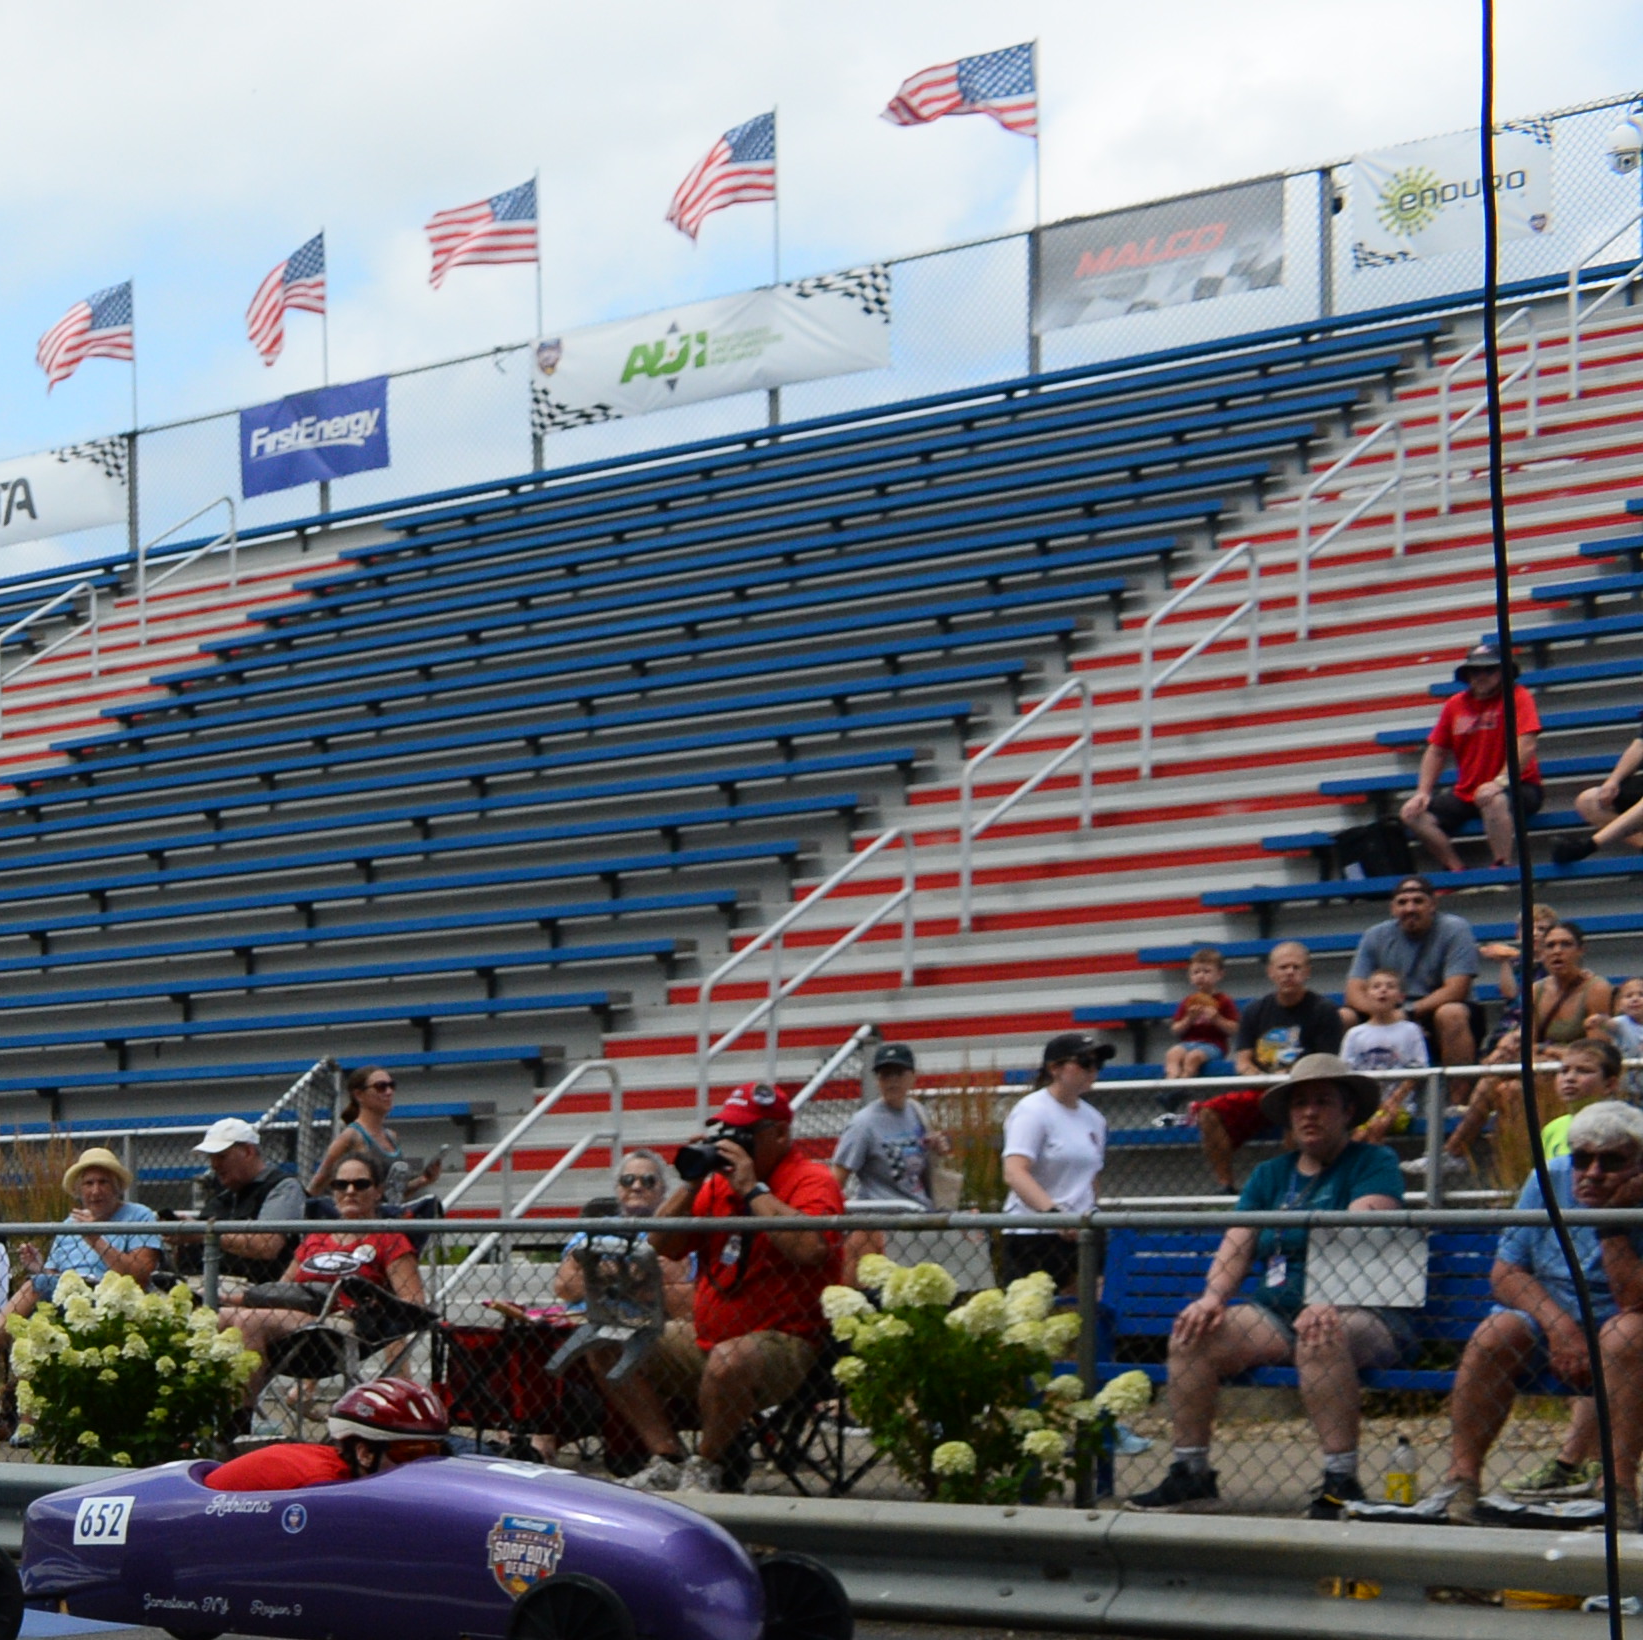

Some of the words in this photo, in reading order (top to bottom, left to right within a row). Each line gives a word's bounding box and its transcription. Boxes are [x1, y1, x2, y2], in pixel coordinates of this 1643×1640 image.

[1074, 222, 1228, 279] MALCO
[249, 408, 381, 459] FirstEnergy
[80, 1502, 125, 1538] 652
[205, 1494, 272, 1517] Adriana
[494, 1541, 526, 1562] SOAP
[526, 1545, 553, 1569] BOX
[249, 1600, 291, 1619] Region
